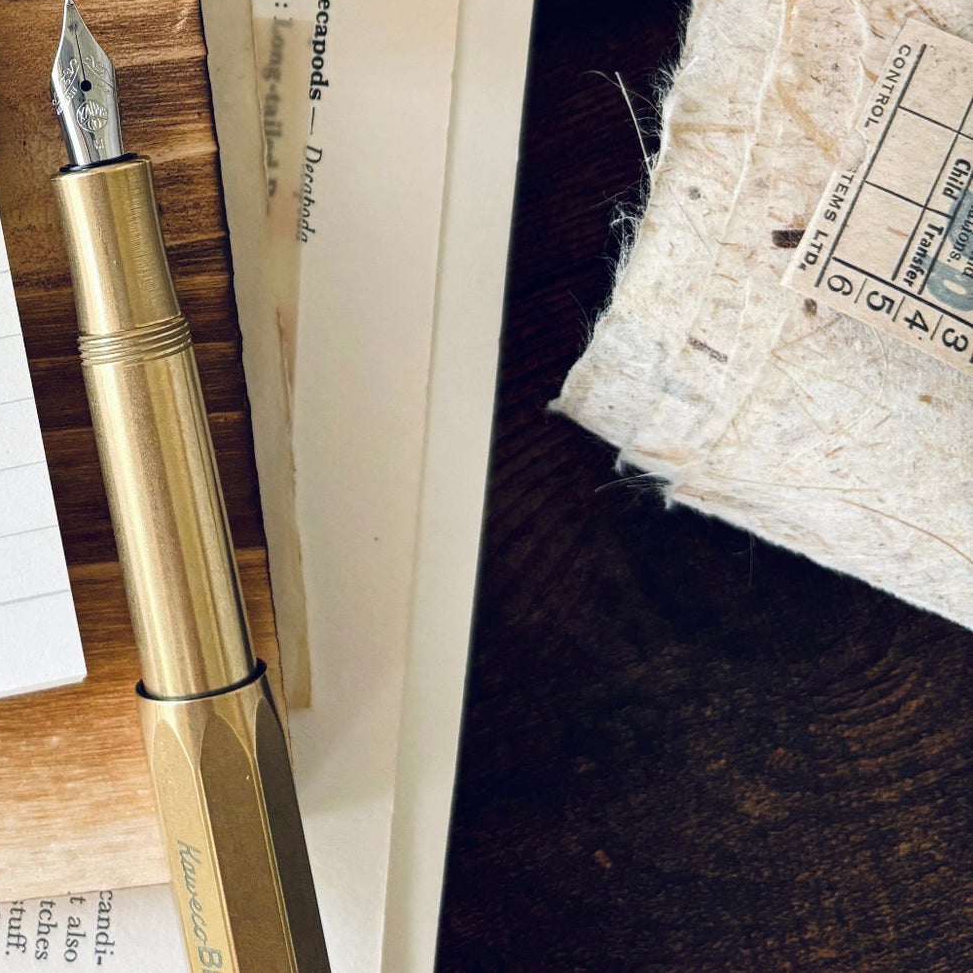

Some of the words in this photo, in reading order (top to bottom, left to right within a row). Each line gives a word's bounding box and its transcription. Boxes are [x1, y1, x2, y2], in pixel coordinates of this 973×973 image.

[863, 43, 912, 128] CONTROL
[942, 158, 972, 201] Child
[903, 222, 945, 288] Transfer
[827, 274, 853, 296] 6
[866, 290, 895, 315] 5
[903, 309, 929, 330] 4
[941, 327, 969, 352] 3
[177, 839, 207, 945] Kaweco
[198, 946, 223, 973] B
[64, 915, 87, 963] also
